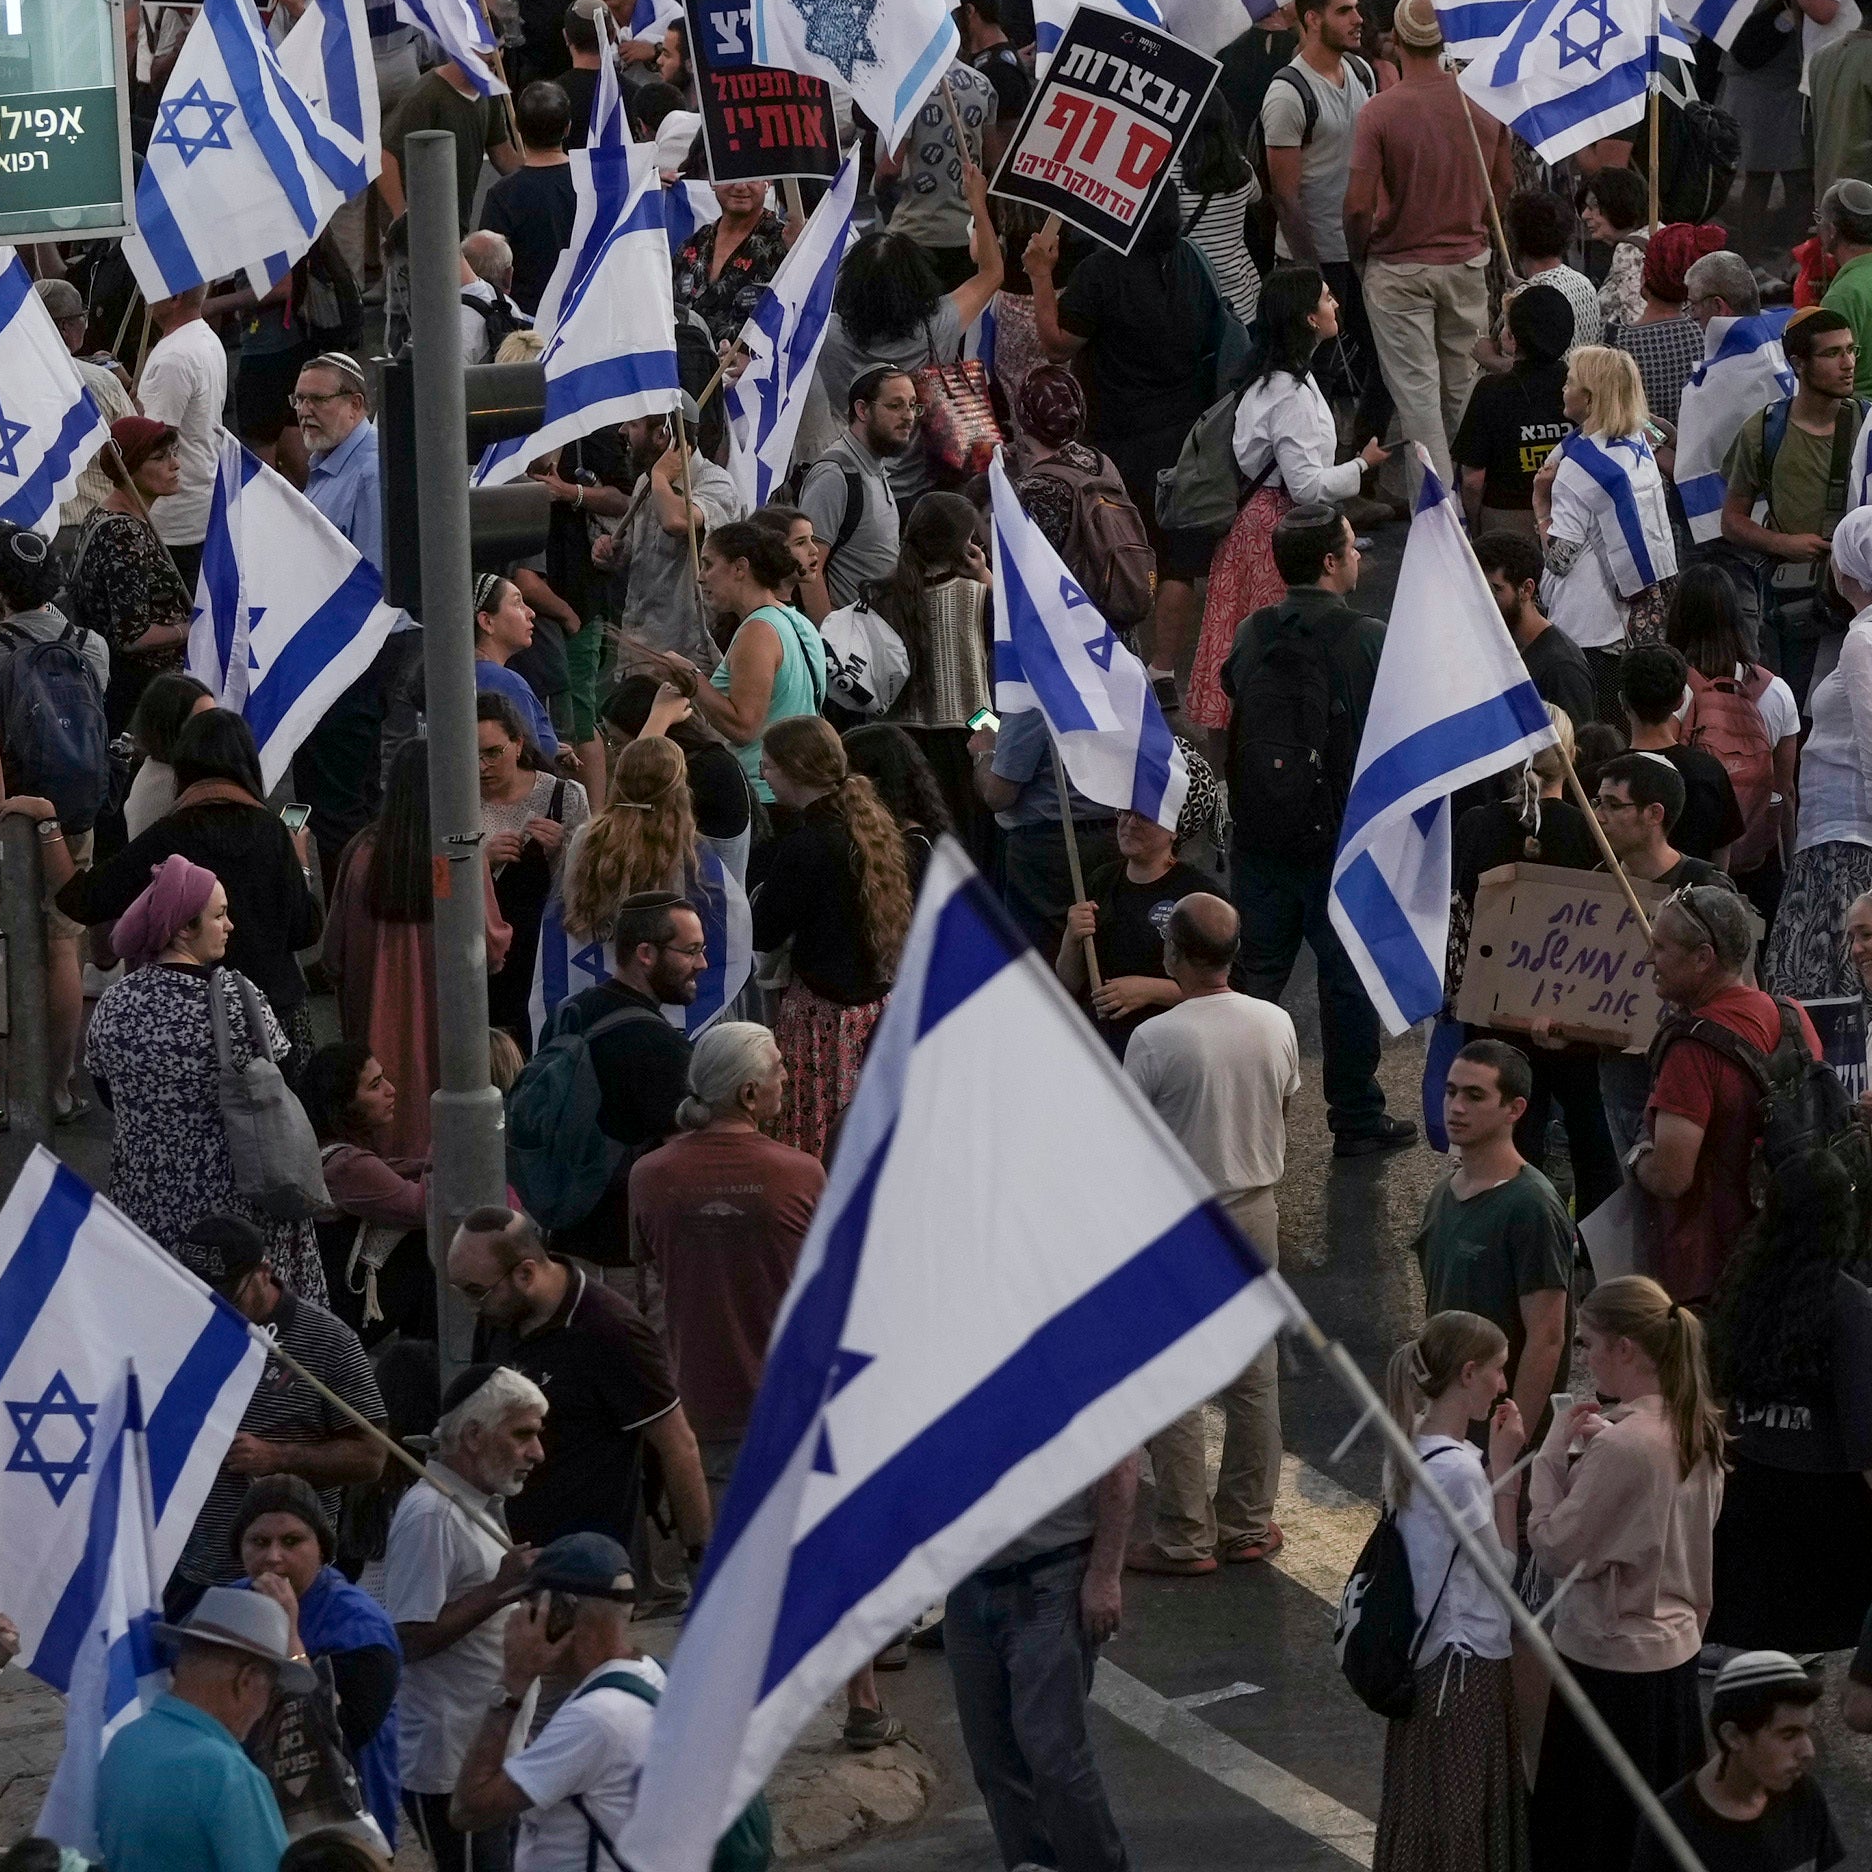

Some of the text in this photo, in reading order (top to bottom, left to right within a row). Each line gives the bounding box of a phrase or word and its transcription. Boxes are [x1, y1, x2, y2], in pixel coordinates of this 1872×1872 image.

[712, 71, 793, 102] תפסול
[1059, 43, 1191, 123] נבצרות
[724, 105, 827, 152] אותי!
[1043, 90, 1174, 192] סוף
[1014, 151, 1136, 222] הדמוקרטיה!
[1520, 422, 1574, 441] כהנא
